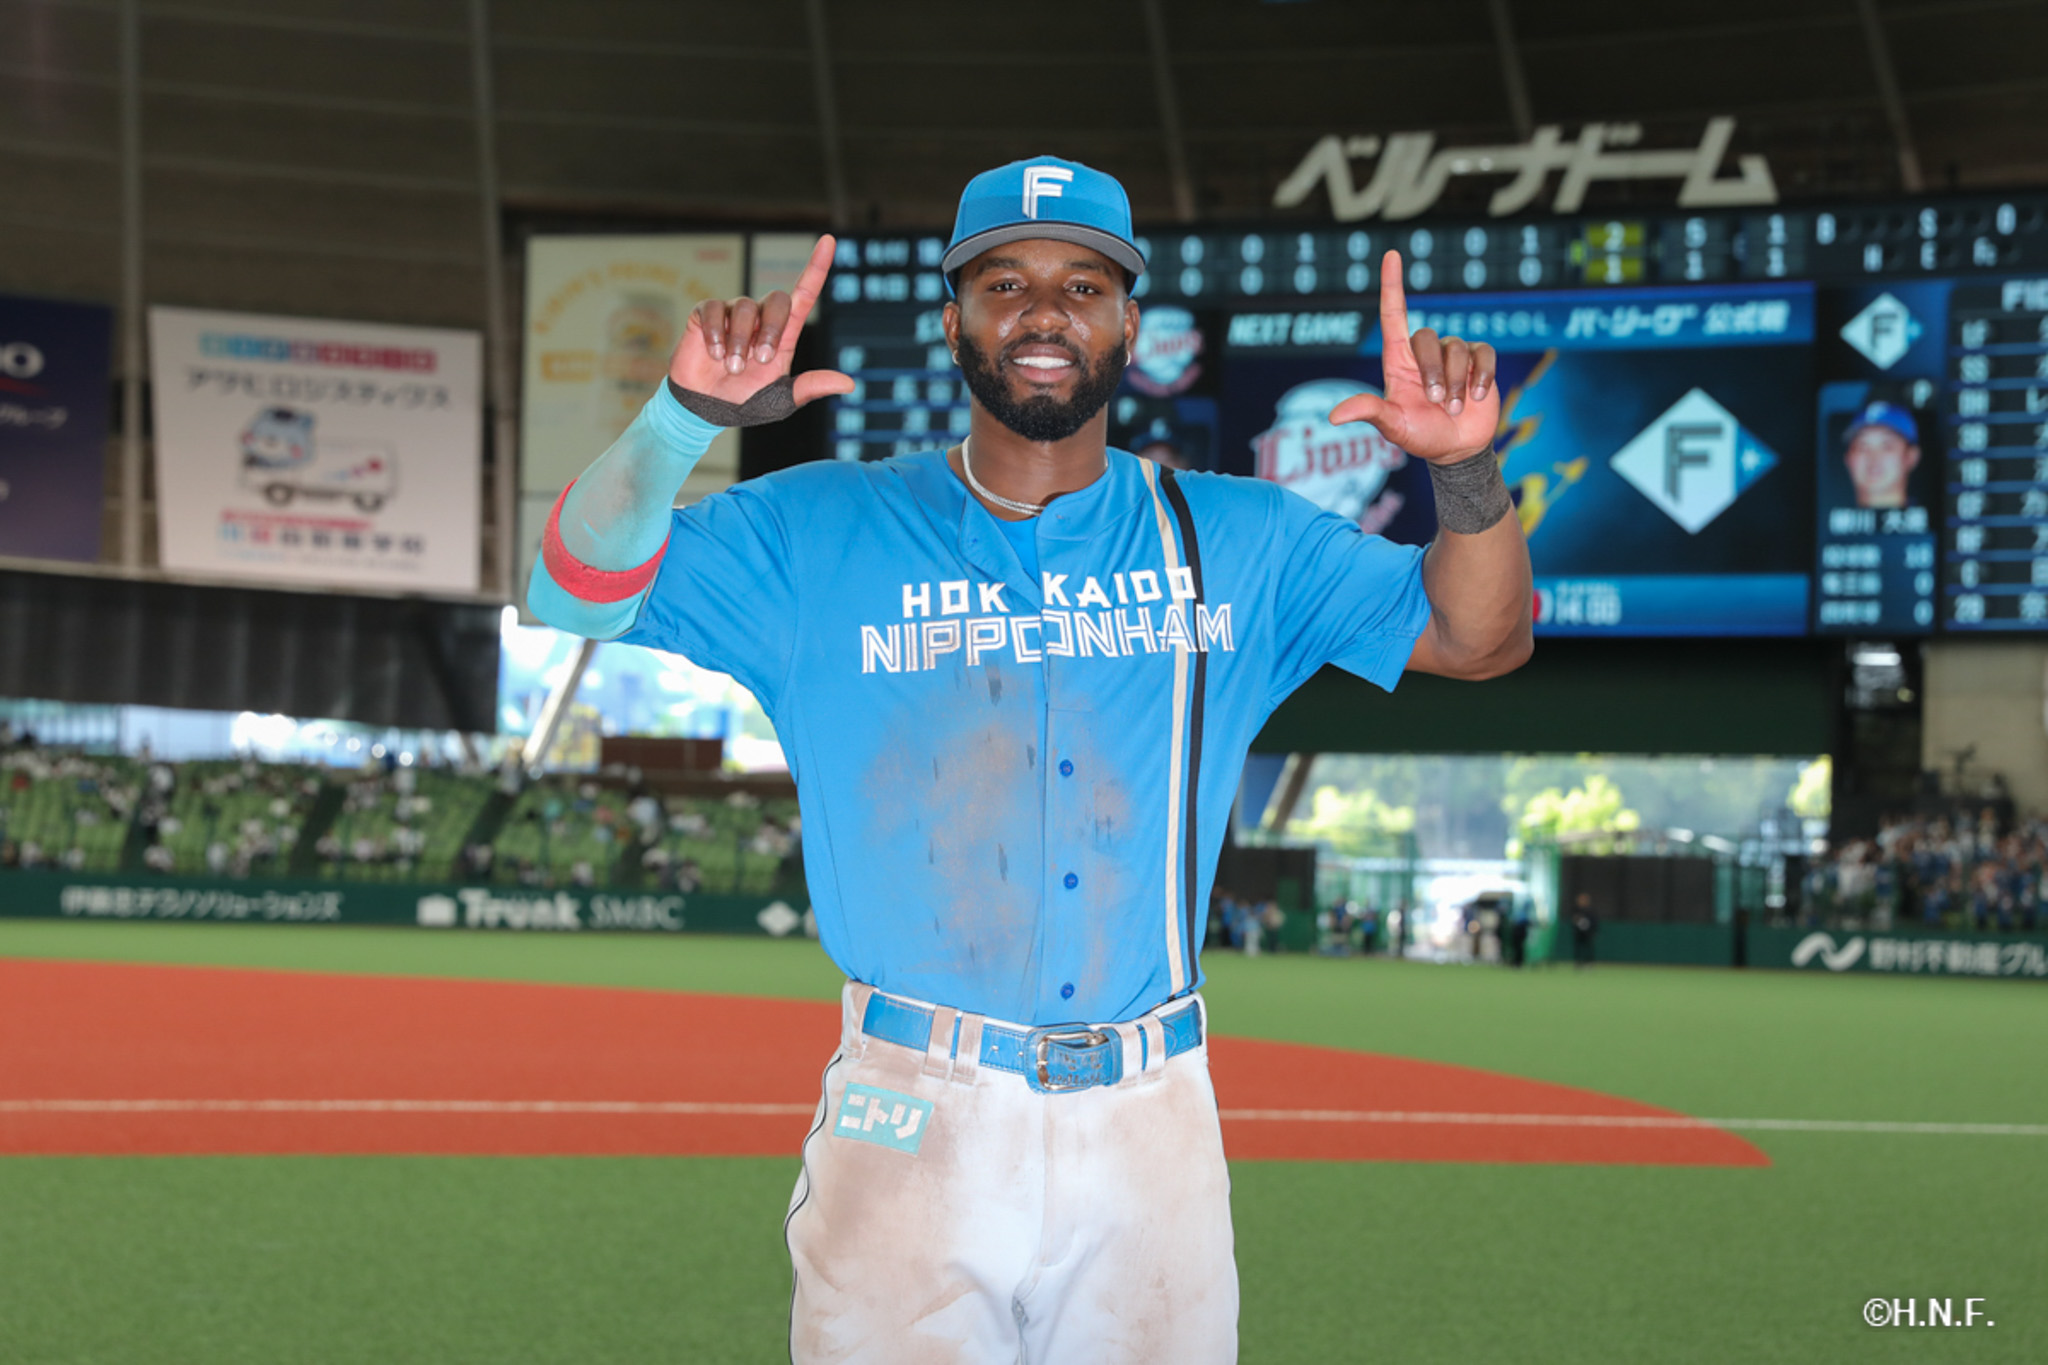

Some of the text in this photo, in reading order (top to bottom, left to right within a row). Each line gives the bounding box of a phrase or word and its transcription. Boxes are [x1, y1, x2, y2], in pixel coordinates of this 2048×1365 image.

[1022, 165, 1074, 219] F
[1919, 208, 1937, 238] S
[1228, 314, 1292, 346] NEXT
[1665, 425, 1724, 503] F
[860, 603, 1235, 674] NIPPONHAM
[460, 888, 684, 930] Trunk SMBC
[840, 1092, 924, 1140] ニトリ
